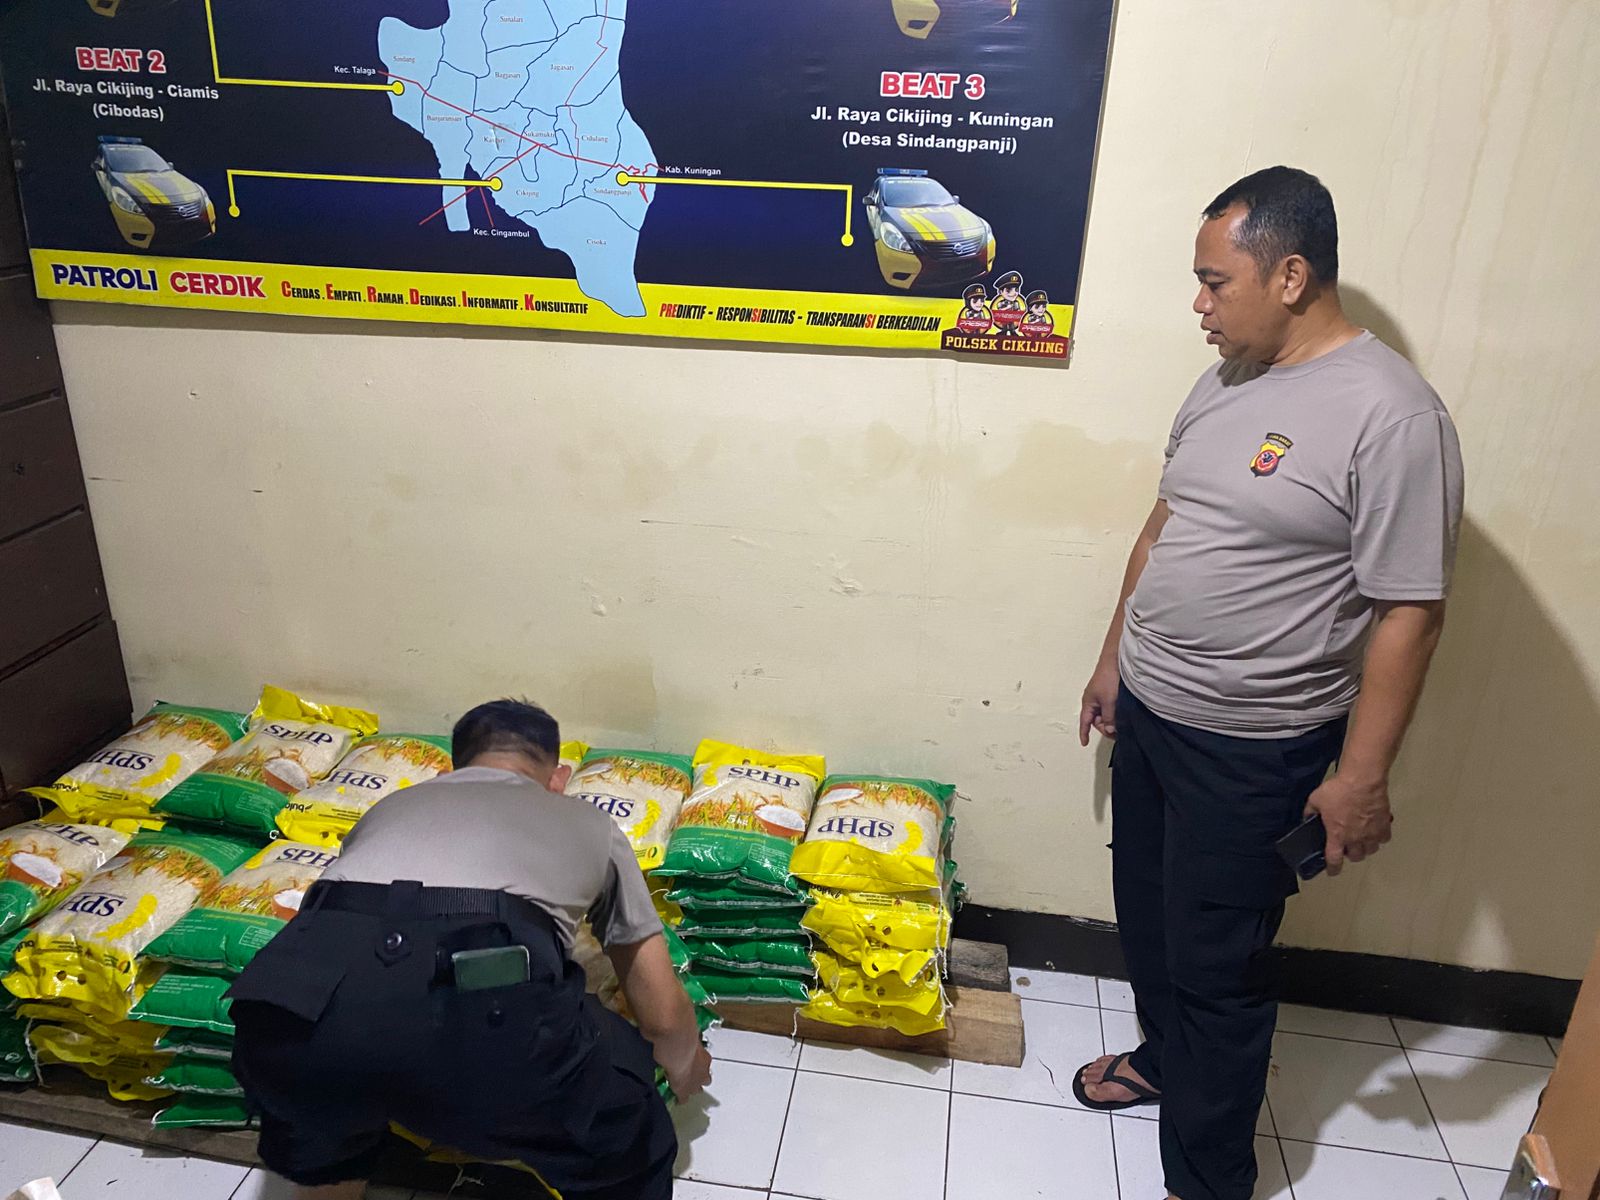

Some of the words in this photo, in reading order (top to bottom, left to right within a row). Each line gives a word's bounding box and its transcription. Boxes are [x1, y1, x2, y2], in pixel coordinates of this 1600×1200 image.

[76, 47, 142, 72] BEAT
[148, 50, 166, 73] 2
[334, 66, 350, 74] Kec.
[352, 66, 376, 76] Talaga
[33, 79, 50, 91] Jl.
[55, 80, 93, 96] Raya
[97, 82, 154, 99] Cikijing
[167, 85, 219, 99] Ciamis
[880, 71, 960, 98] BEAT
[964, 73, 985, 100] 3
[93, 103, 164, 121] (Cibodas)
[811, 106, 832, 120] Jl.
[838, 107, 880, 124] Raya
[886, 108, 952, 127] Cikijing
[969, 111, 1053, 130] Kuningan
[842, 131, 891, 148] (Desa
[897, 133, 1017, 154] Sindangpanji)
[665, 166, 682, 174] Kab.
[684, 166, 721, 176] Kuningan
[473, 228, 490, 236] Kec.
[491, 229, 530, 238] Cingambul
[50, 263, 158, 291] PATROLI
[169, 271, 267, 298] CERDIK
[659, 303, 706, 319] PREDIKTIF
[716, 308, 795, 324] RESPONSIBILITAS
[805, 311, 876, 328] TRANSPARANSI
[876, 315, 941, 331] BERKEADILAN
[946, 336, 998, 350] POLSEK
[1002, 338, 1064, 354] CIKIJING
[264, 724, 333, 745] SPHP
[88, 751, 153, 770] SPH
[328, 770, 388, 790] SPH
[728, 767, 800, 788] SPHP
[284, 802, 305, 813] bulo
[818, 817, 895, 838] SPHP
[276, 847, 338, 868] SPH
[59, 895, 124, 917] SPH
